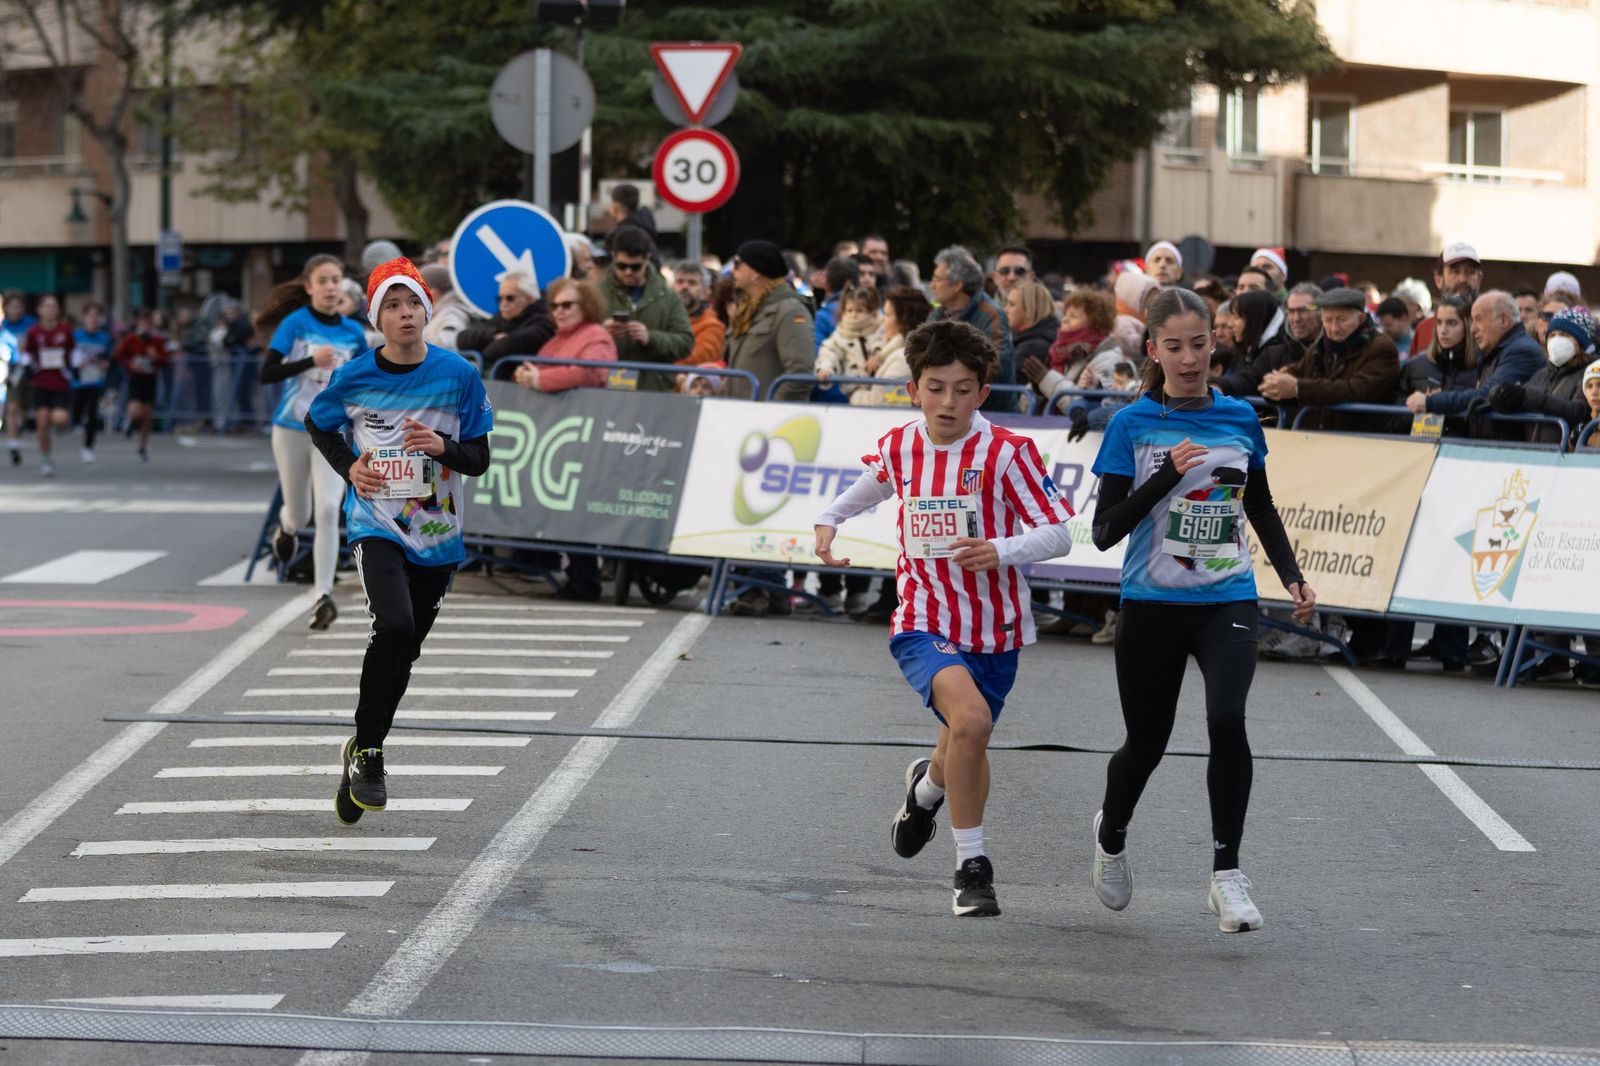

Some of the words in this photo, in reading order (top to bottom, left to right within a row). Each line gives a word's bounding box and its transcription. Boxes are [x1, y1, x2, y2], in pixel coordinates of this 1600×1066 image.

[673, 159, 717, 184] 30
[379, 449, 424, 458] SETEL
[373, 460, 414, 480] 6204
[760, 463, 868, 498] SETE
[619, 489, 673, 506] SOLUCIONES
[918, 499, 967, 510] SETEL
[587, 501, 626, 516] VISUALES
[627, 505, 635, 515] A
[635, 505, 670, 520] MEDIDA
[1191, 504, 1234, 515] SETEL
[911, 513, 957, 537] 6259
[1178, 515, 1223, 540] 6190
[1535, 531, 1555, 549] San
[1528, 551, 1543, 569] de
[1544, 551, 1585, 571] Kostka
